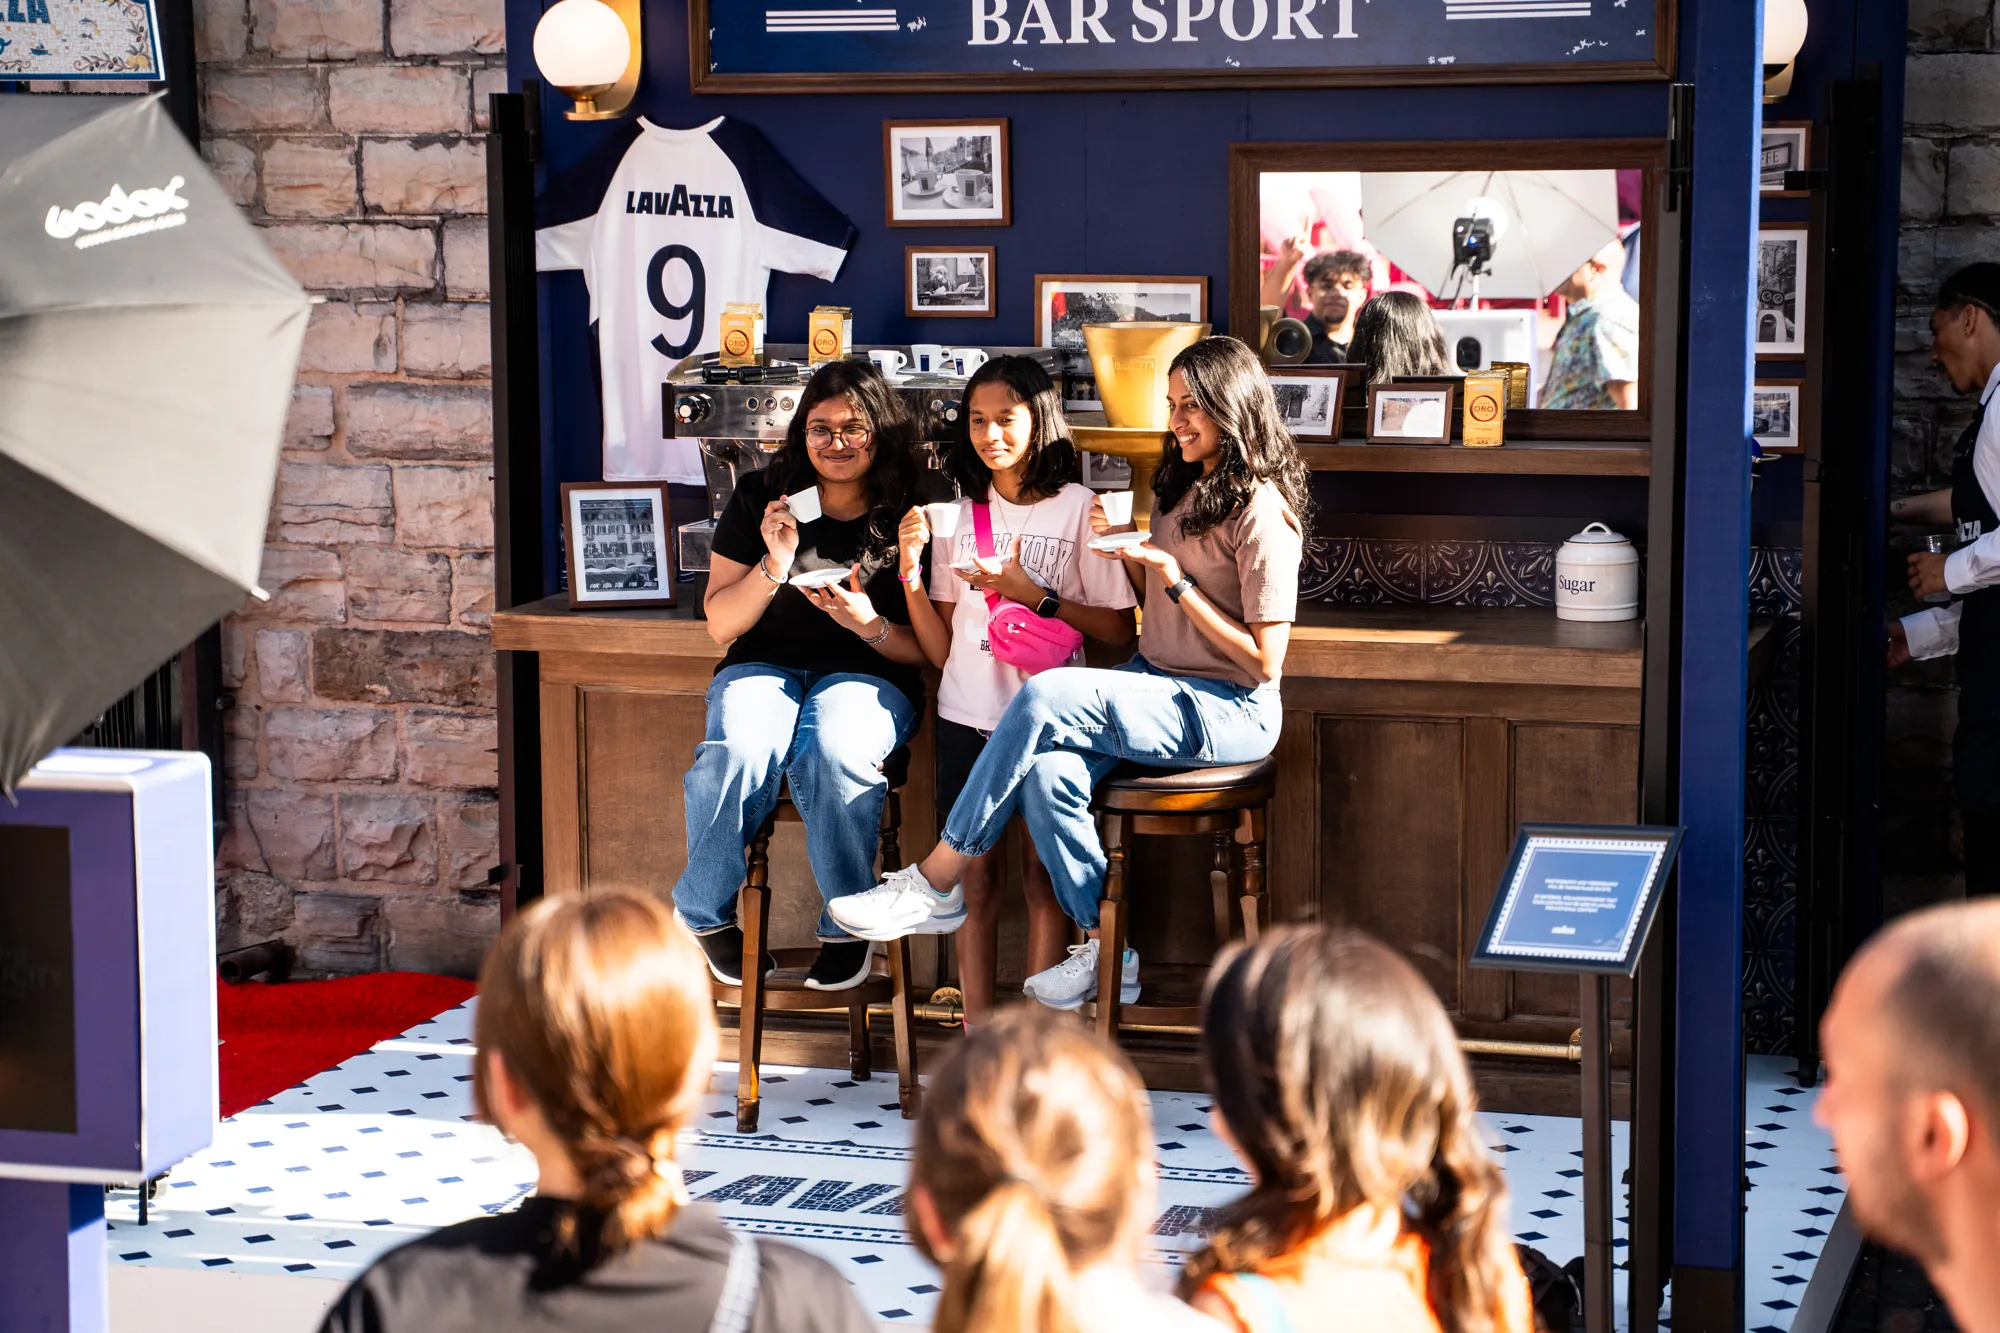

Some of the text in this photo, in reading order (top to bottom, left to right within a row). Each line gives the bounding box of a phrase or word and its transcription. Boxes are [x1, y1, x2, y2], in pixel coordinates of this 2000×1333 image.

[968, 0, 1370, 45] BAR SPORT
[626, 184, 735, 219] LAVAZZA
[646, 244, 706, 360] 9
[816, 338, 835, 346] ORO
[1473, 405, 1494, 413] ORO
[1019, 533, 1076, 594] YORK
[1558, 574, 1596, 596] Sugar
